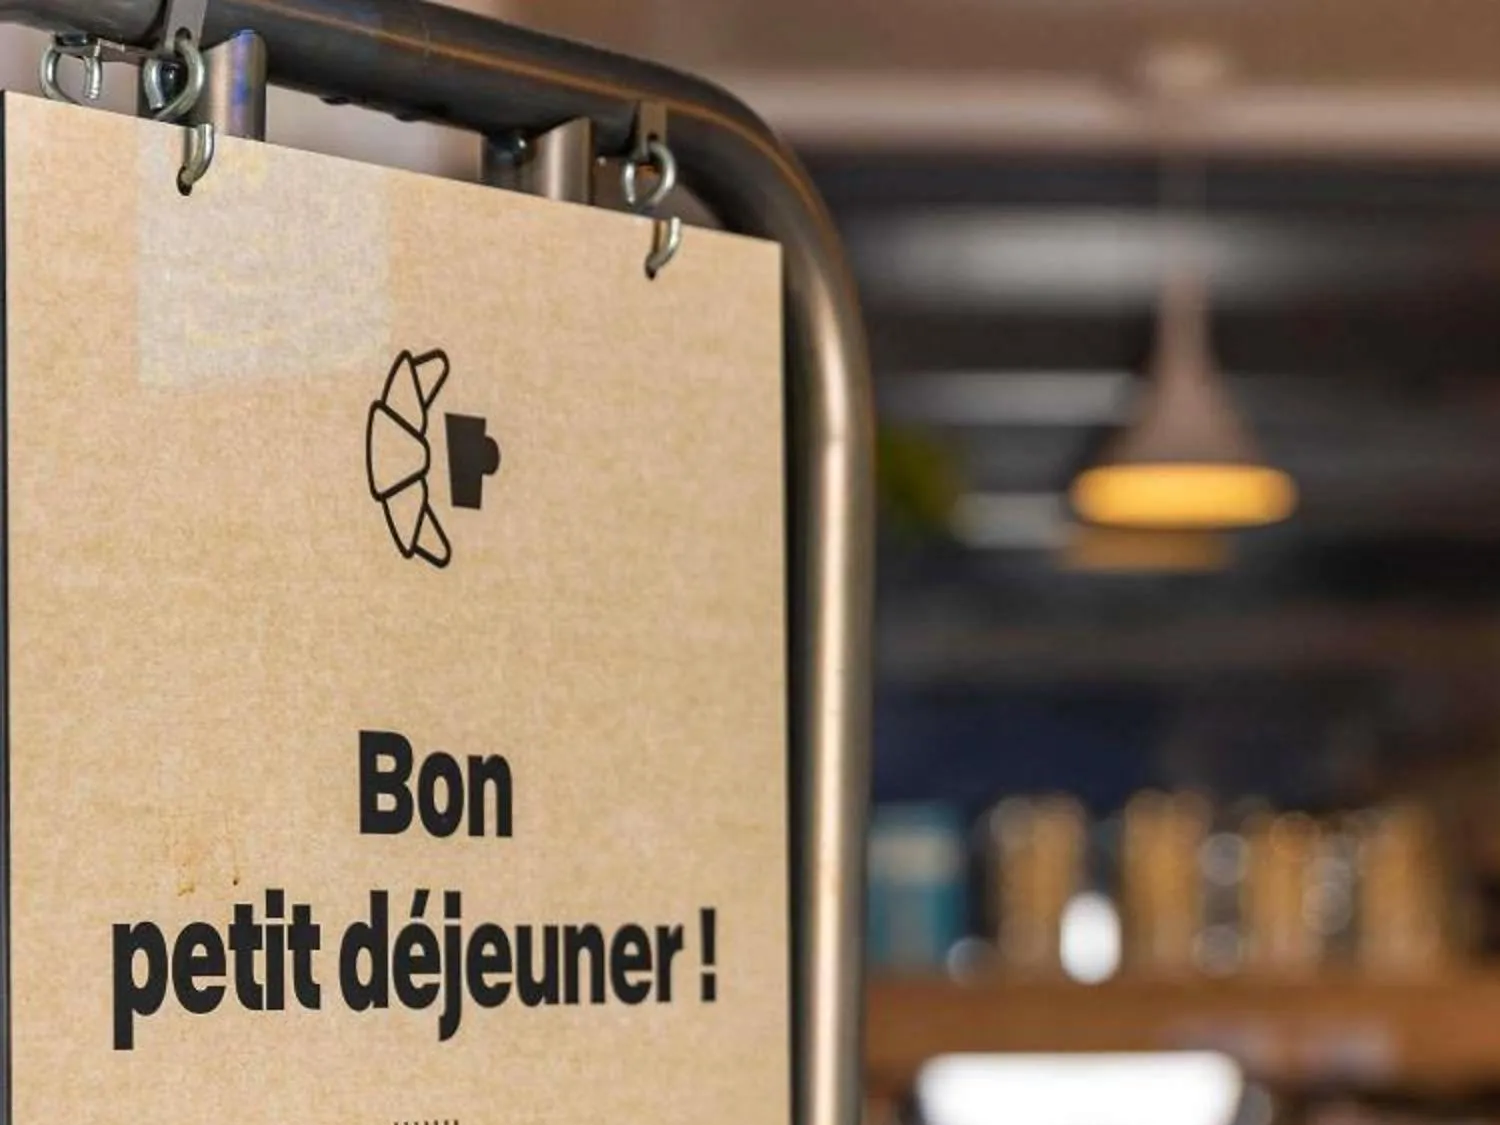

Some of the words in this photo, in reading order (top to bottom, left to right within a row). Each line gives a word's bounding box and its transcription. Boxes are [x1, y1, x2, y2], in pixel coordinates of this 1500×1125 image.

[358, 729, 514, 839] Bon
[111, 887, 322, 1052] petit
[338, 888, 685, 1043] déjeuner
[699, 906, 717, 1004] !
